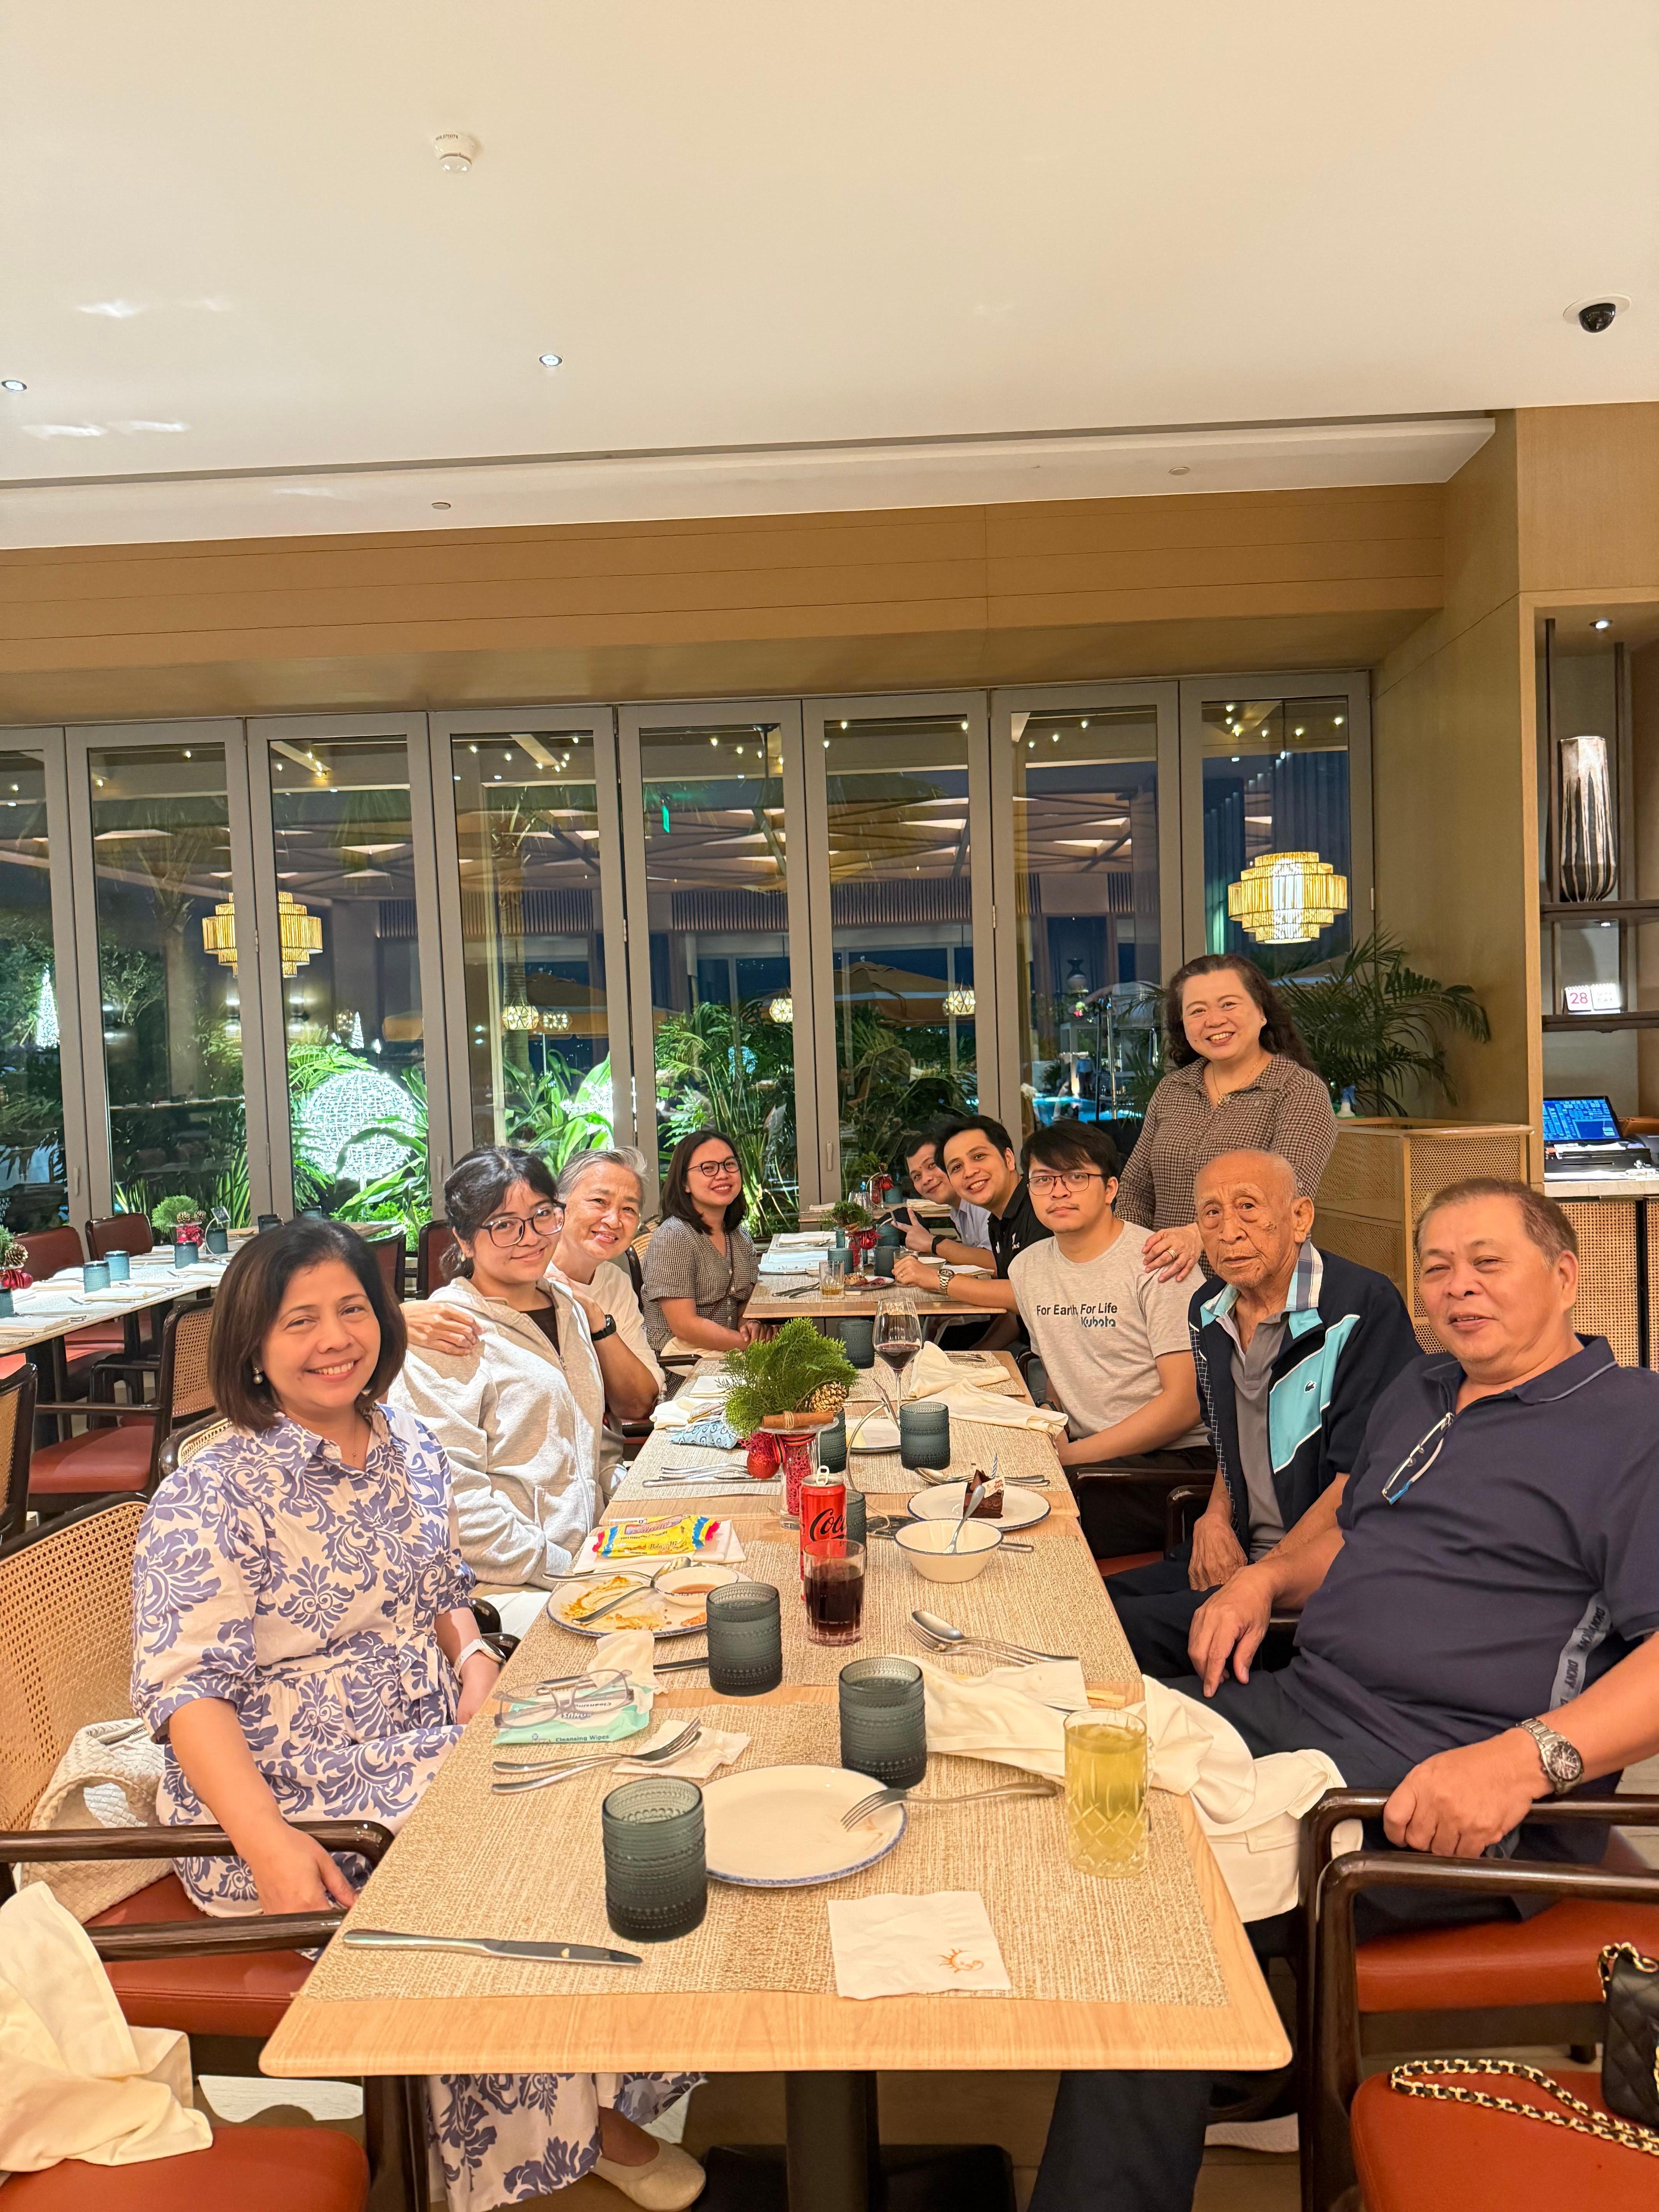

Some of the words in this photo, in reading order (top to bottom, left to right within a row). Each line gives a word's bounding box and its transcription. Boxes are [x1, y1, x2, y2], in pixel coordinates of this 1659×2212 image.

[1570, 992, 1588, 1004] 28
[1036, 1305, 1051, 1316] For
[1054, 1304, 1079, 1316] Earth,
[1080, 1304, 1096, 1315] For
[1098, 1302, 1118, 1314] Life
[1081, 1316, 1116, 1328] Kubota
[1565, 1659, 1578, 1688] DKNY
